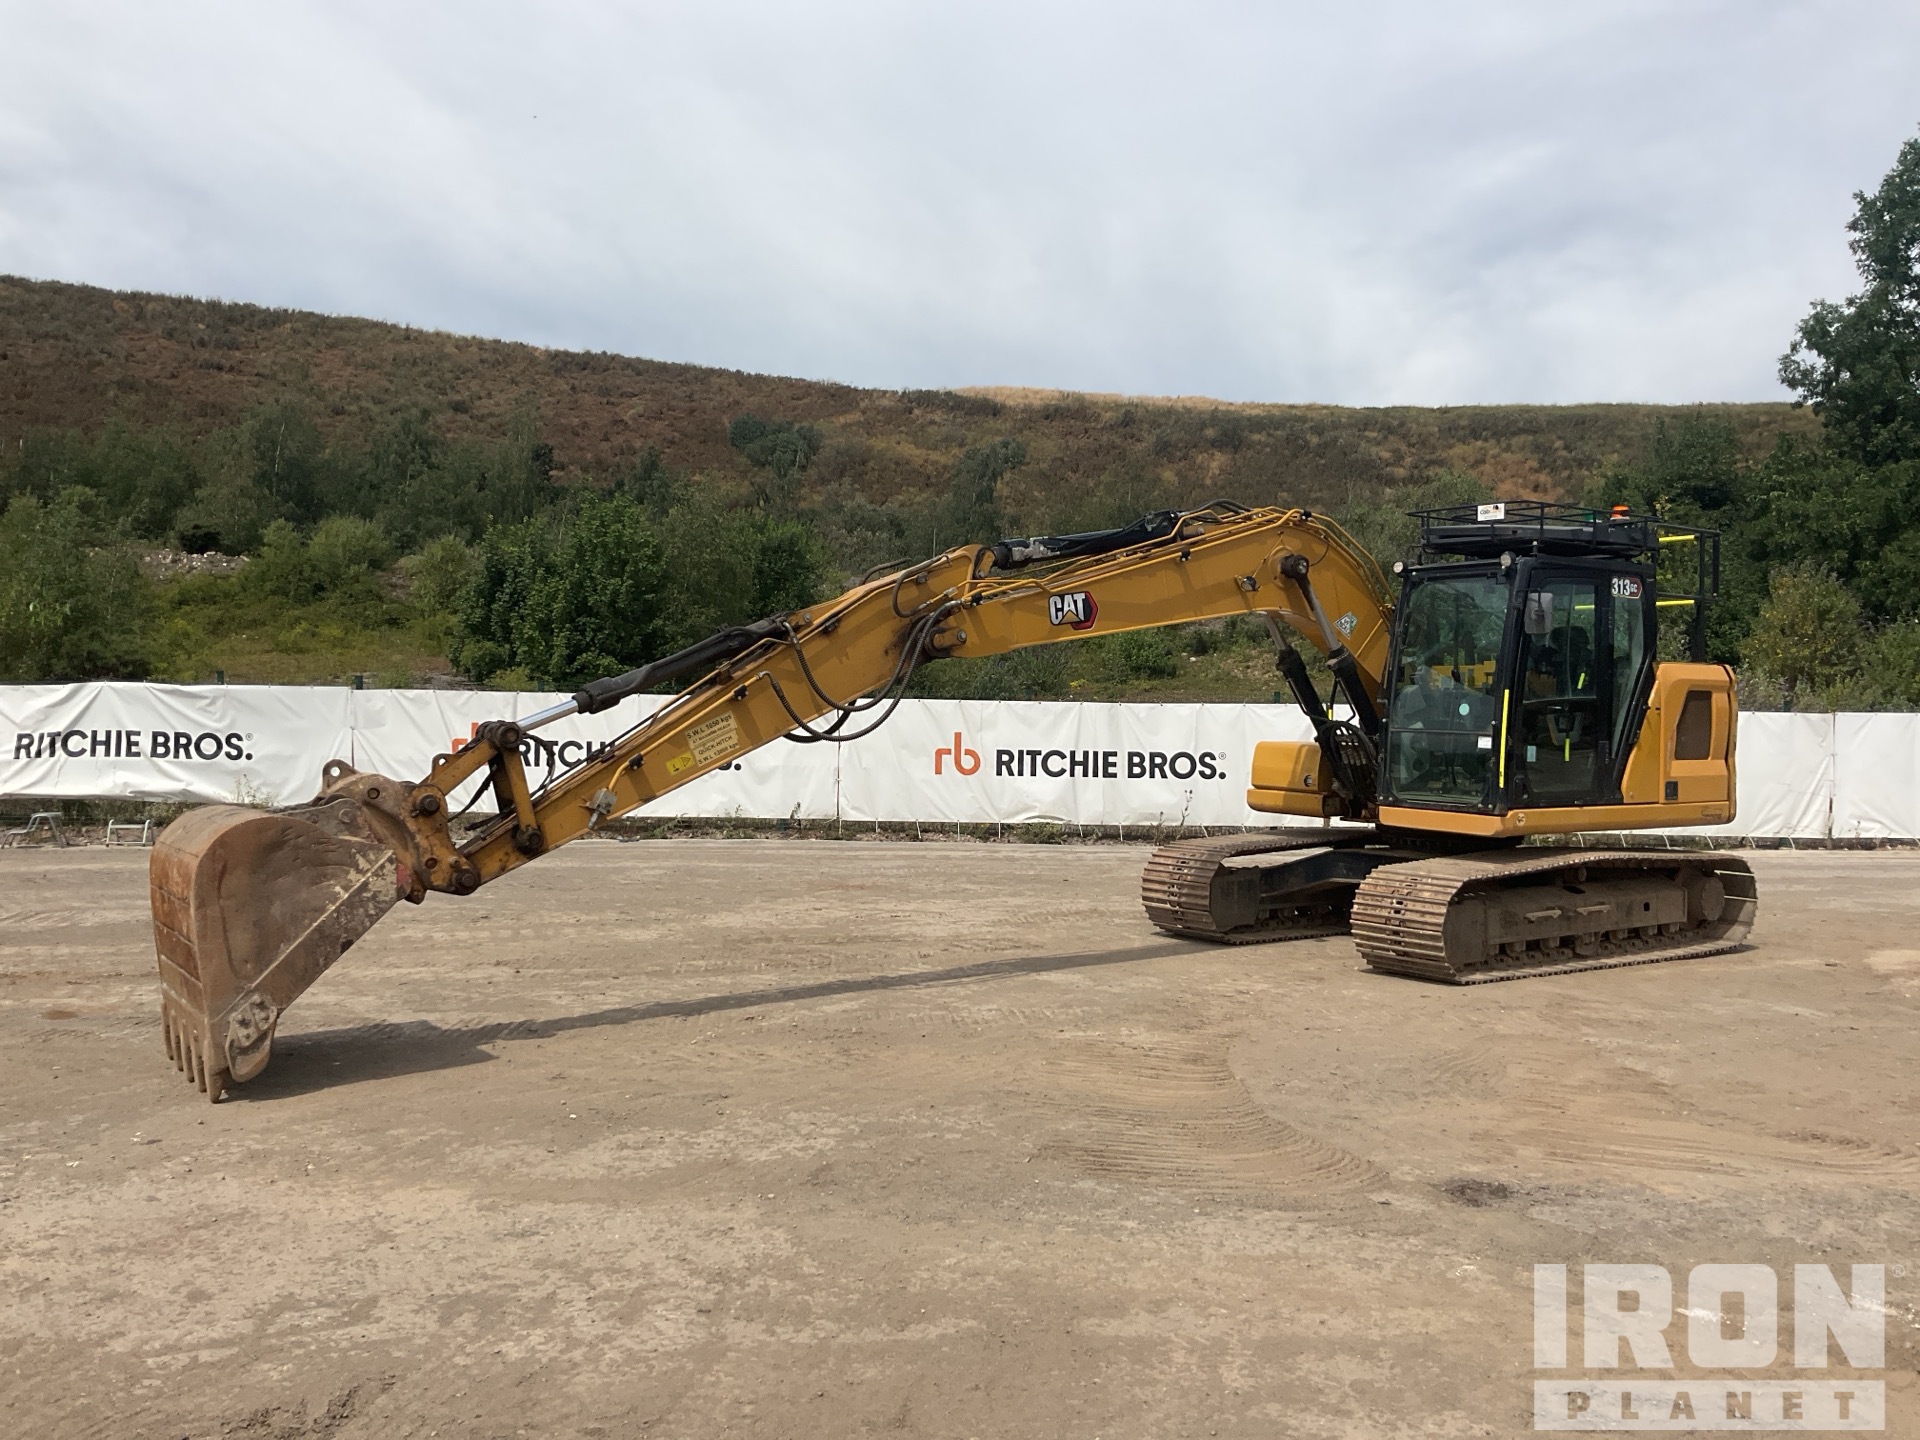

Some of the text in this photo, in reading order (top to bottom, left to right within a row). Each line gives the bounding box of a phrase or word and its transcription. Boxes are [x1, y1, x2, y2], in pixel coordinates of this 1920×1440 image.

[1049, 592, 1086, 625] CAT
[14, 730, 141, 759] RITCHIE
[698, 735, 732, 755] QUICK-HITCH
[996, 750, 1118, 778] RITCHIE
